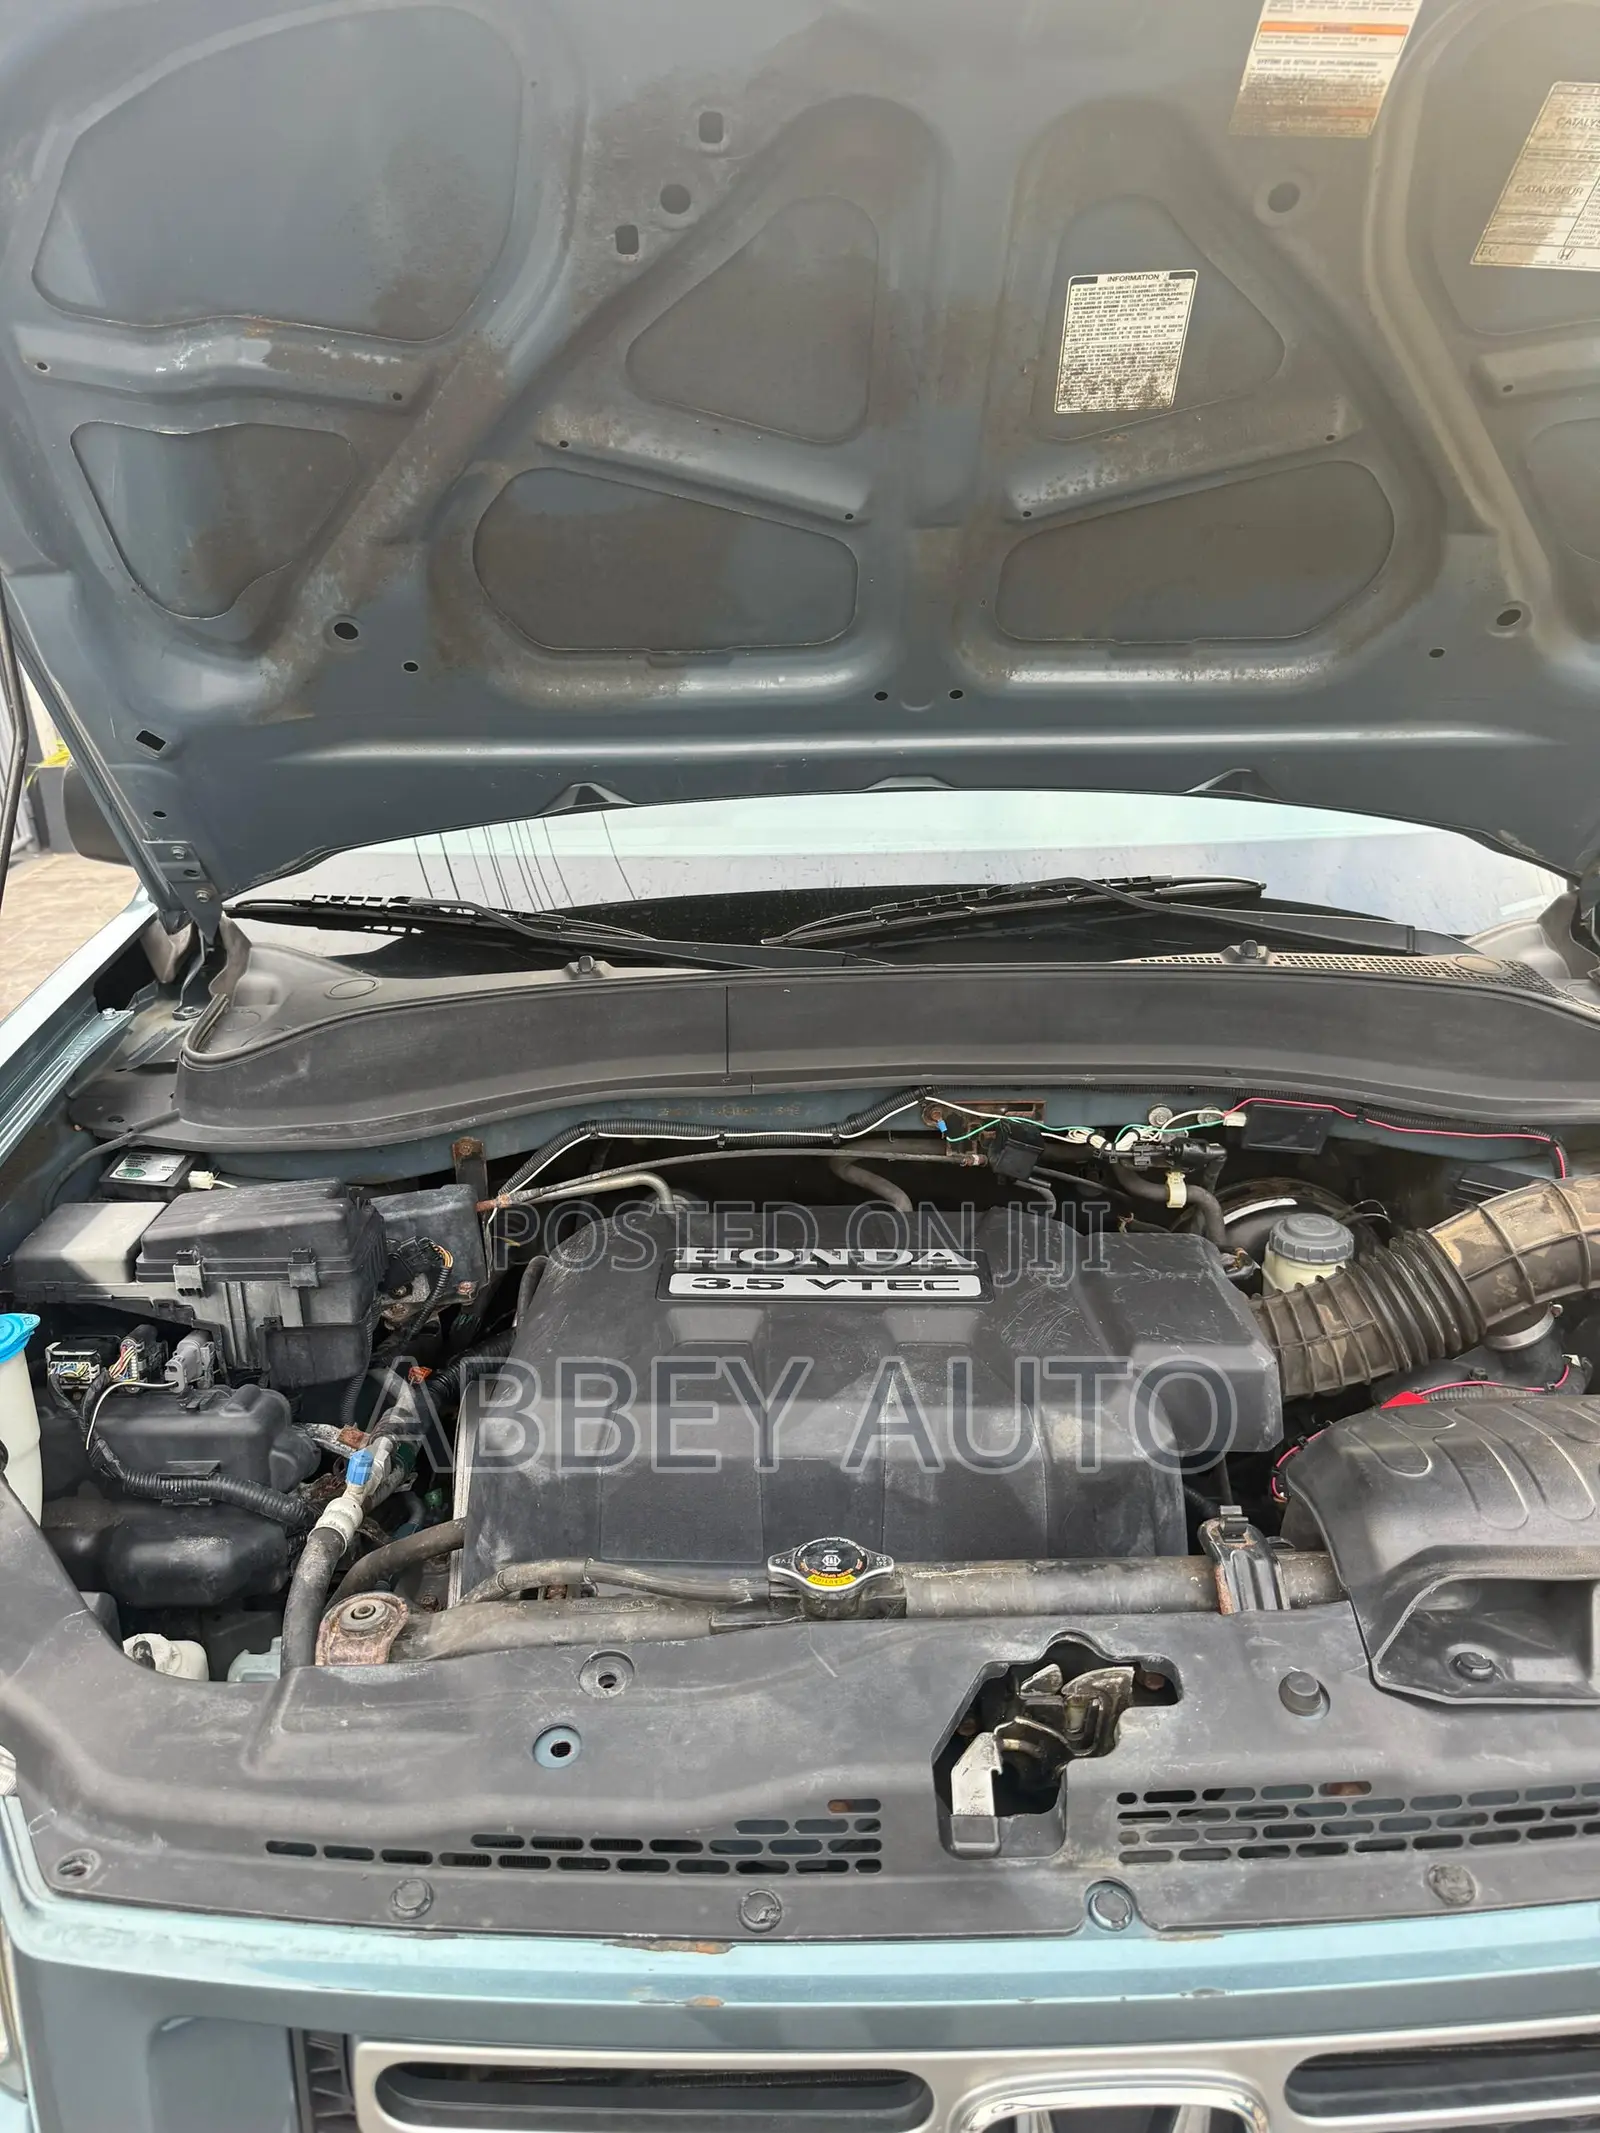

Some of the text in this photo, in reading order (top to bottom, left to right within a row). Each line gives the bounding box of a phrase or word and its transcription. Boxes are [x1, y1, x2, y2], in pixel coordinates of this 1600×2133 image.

[1107, 273, 1160, 283] INFORMATION
[673, 1247, 980, 1270] HONDA
[691, 1276, 961, 1292] 3.5 VTEC
